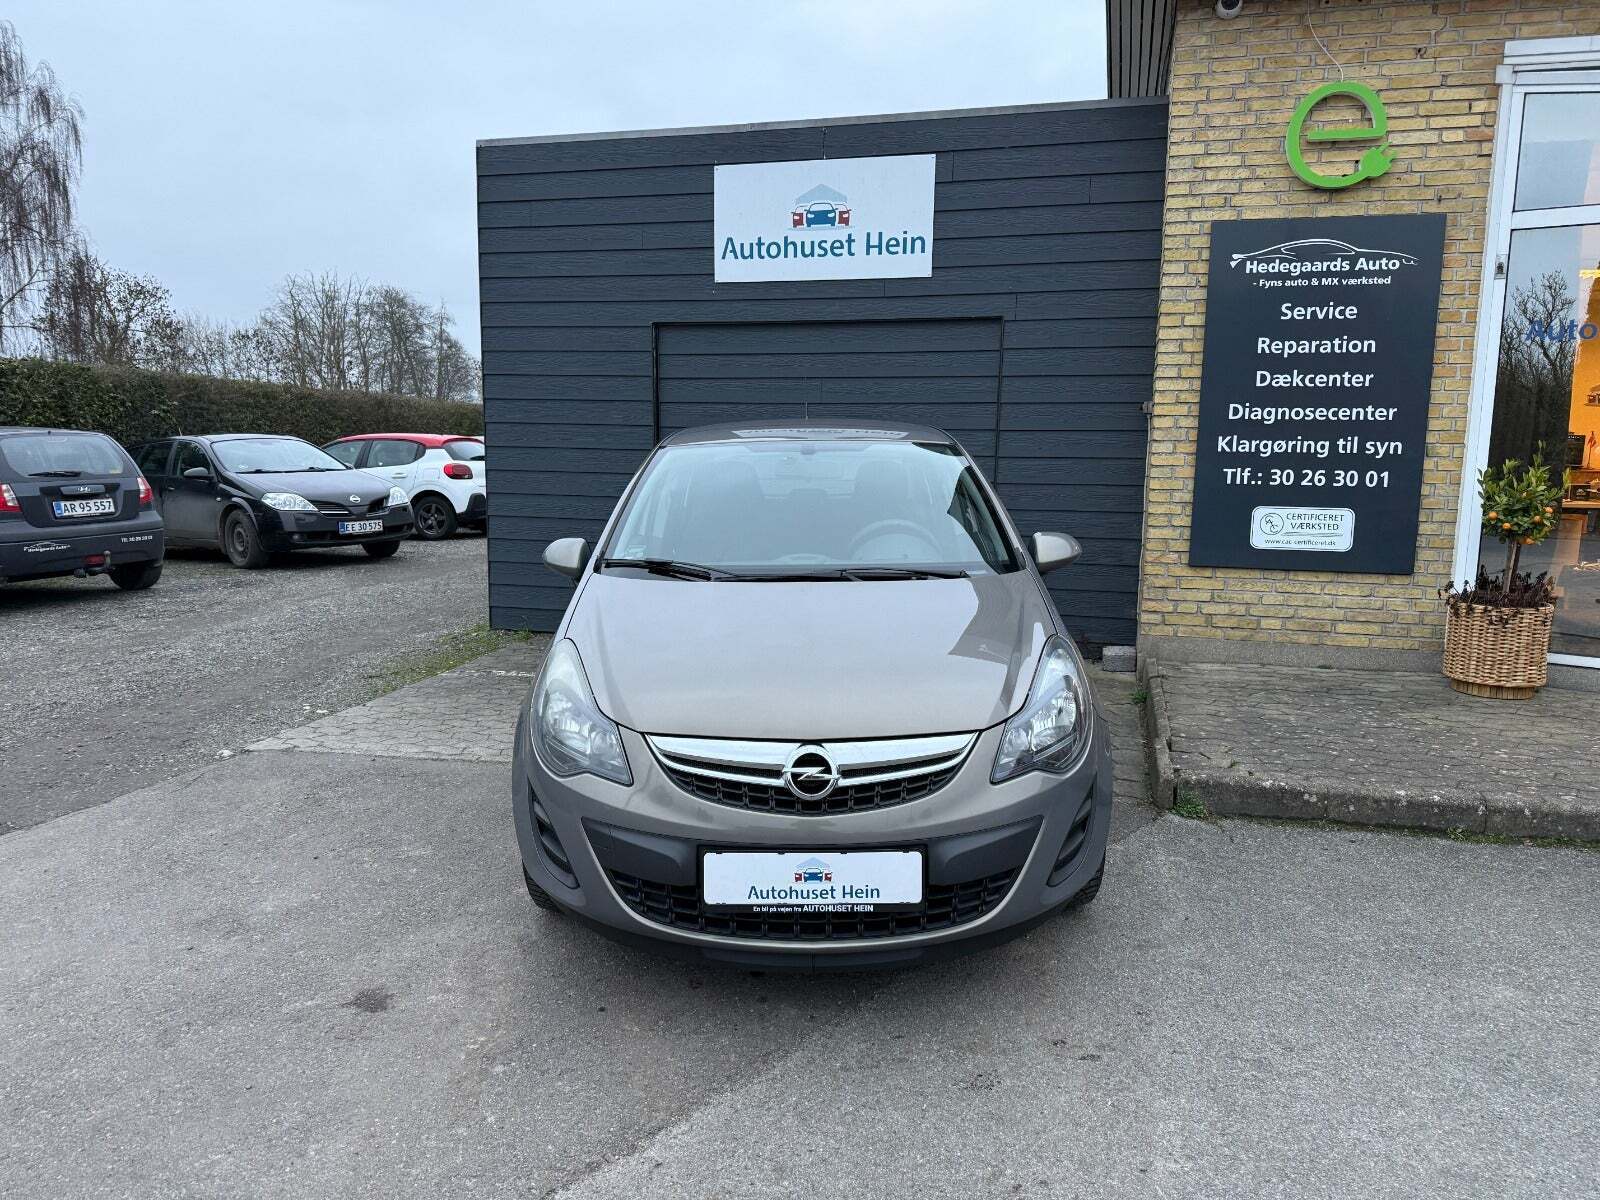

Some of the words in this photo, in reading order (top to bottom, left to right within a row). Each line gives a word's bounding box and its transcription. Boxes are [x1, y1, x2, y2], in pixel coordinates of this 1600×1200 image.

[721, 232, 856, 260] Autohuset
[865, 230, 926, 256] Hein
[1245, 259, 1350, 276] Hedegaards
[1354, 257, 1400, 271] Auto
[1259, 280, 1283, 289] Fyns
[1284, 278, 1309, 287] auto
[1311, 277, 1319, 286] &
[1321, 277, 1339, 286] MX
[1341, 275, 1392, 285] værksted
[1280, 302, 1358, 320] Service
[1525, 319, 1599, 342] Auto
[1257, 336, 1376, 358] Reparation
[1255, 369, 1374, 387] Dækcenter
[1228, 402, 1398, 425] Diagnosecenter
[1217, 435, 1330, 458] Klargøring
[1337, 436, 1359, 454] til
[1365, 440, 1403, 459] syn
[1223, 467, 1263, 485] Tlf.:
[1269, 469, 1295, 486] 30
[1300, 469, 1326, 486] 26
[1333, 470, 1359, 487] 30
[1365, 470, 1390, 488] 01
[63, 503, 77, 514] AR
[79, 502, 92, 513] 95
[93, 500, 112, 511] 557
[1286, 512, 1345, 522] CERTIFICERET
[357, 522, 368, 531] 30
[1290, 522, 1339, 531] VÆRKSTED
[748, 885, 836, 900] Autohuset
[842, 885, 880, 899] Hein
[769, 905, 777, 913] på
[777, 906, 793, 914] vejen
[802, 904, 853, 912] AUTOHUSET
[854, 904, 874, 912] HEIN
